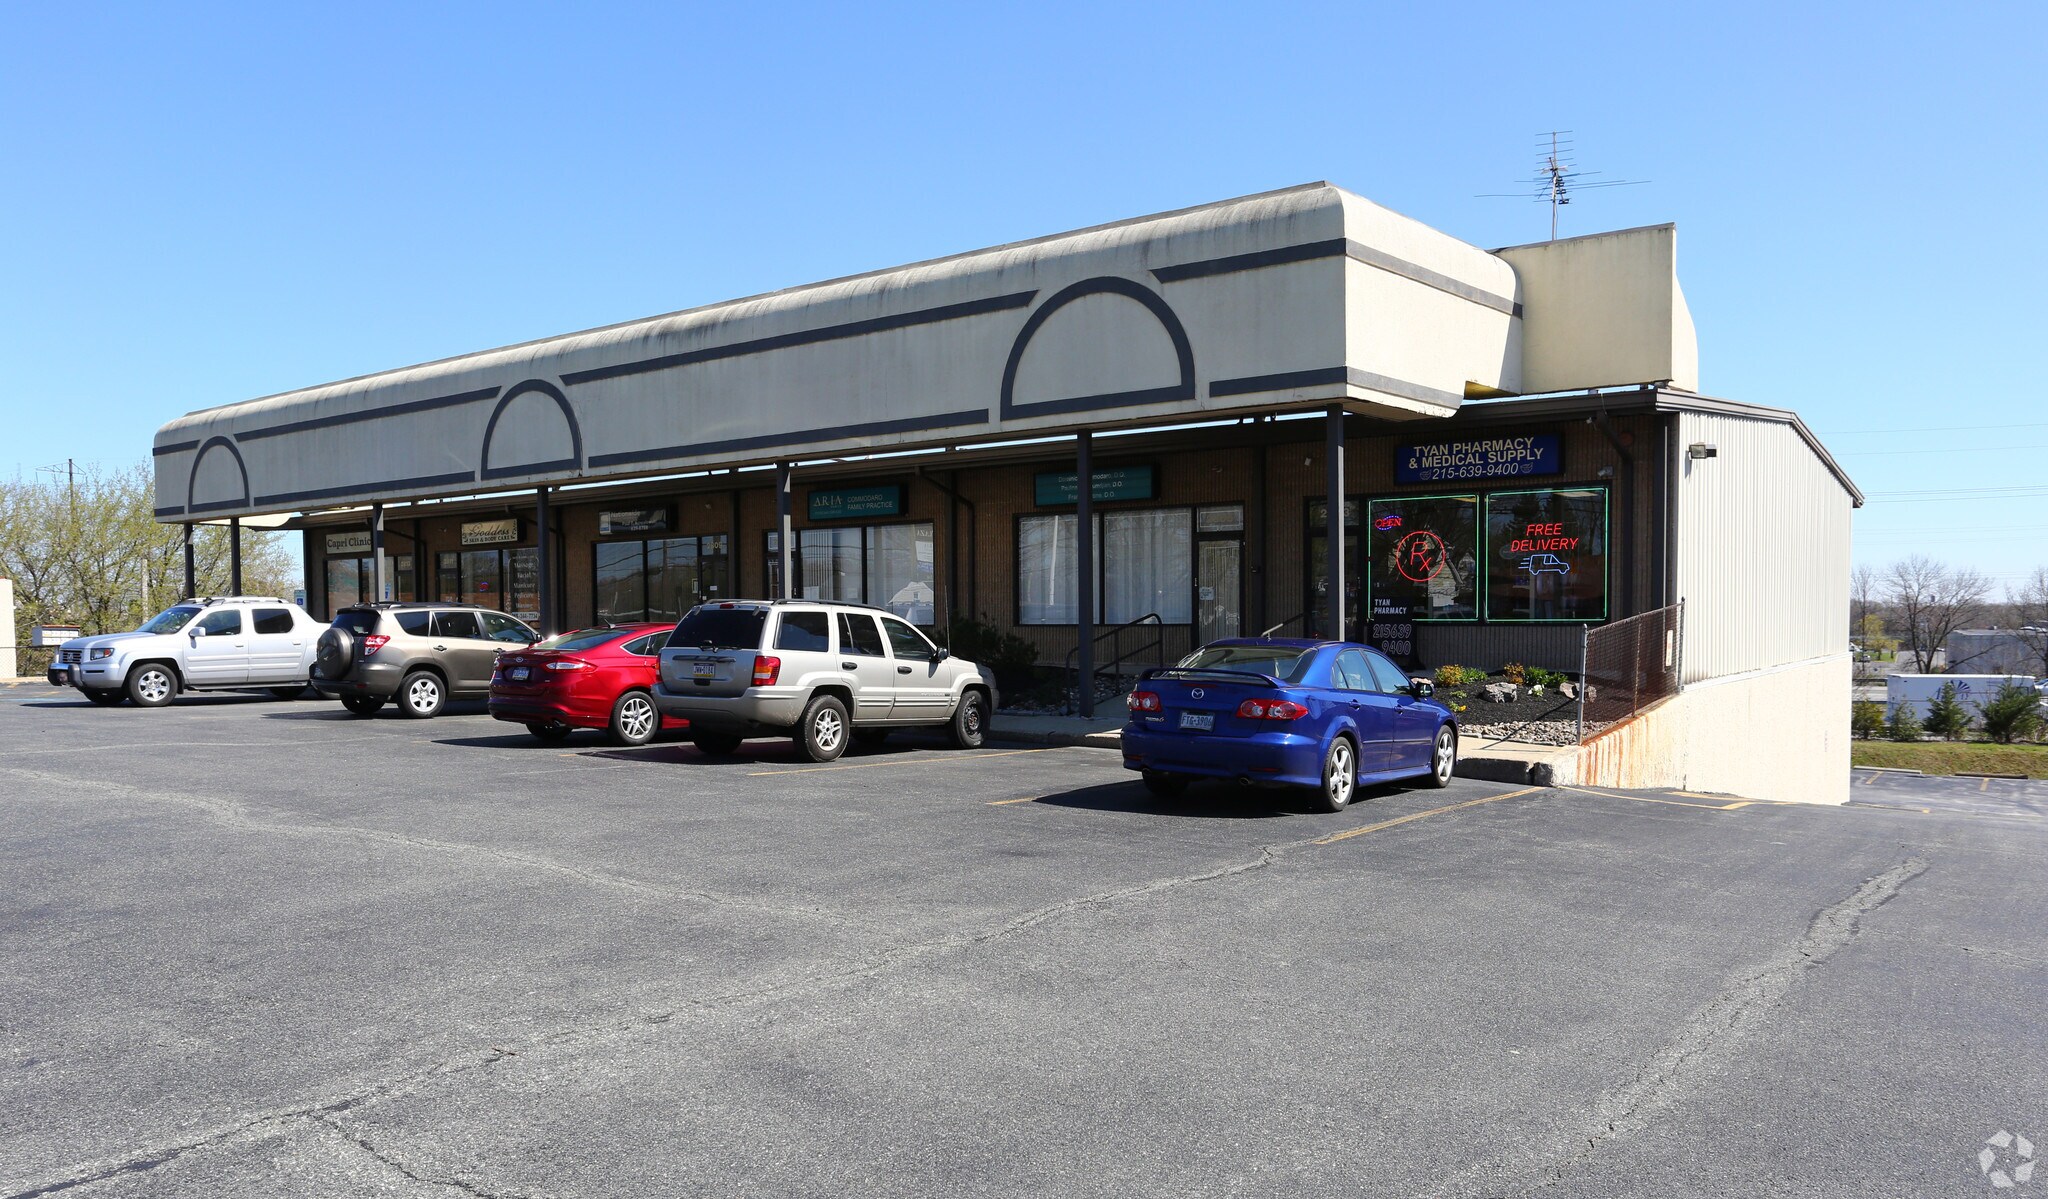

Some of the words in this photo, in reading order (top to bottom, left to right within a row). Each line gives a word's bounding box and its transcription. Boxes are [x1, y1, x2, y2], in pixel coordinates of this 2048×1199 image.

[1413, 444, 1449, 457] TYAN
[1452, 437, 1535, 454] PHARMACY
[1408, 457, 1418, 469] &
[1421, 453, 1484, 467] MEDICAL
[1487, 448, 1544, 463] SUPPLY
[1432, 463, 1519, 480] 215-639-9400
[813, 495, 842, 507] ARIA
[847, 503, 865, 511] FAMILY
[866, 501, 893, 509] PRACTICE
[468, 522, 510, 537] Goddess
[1375, 517, 1402, 528] OPEN
[1526, 522, 1562, 537] FREE
[327, 538, 347, 549] Capri
[349, 536, 372, 547] Clinic
[1511, 537, 1579, 552] DELIVERY
[1373, 607, 1407, 615] PHARMACY
[1381, 640, 1412, 655] 9400
